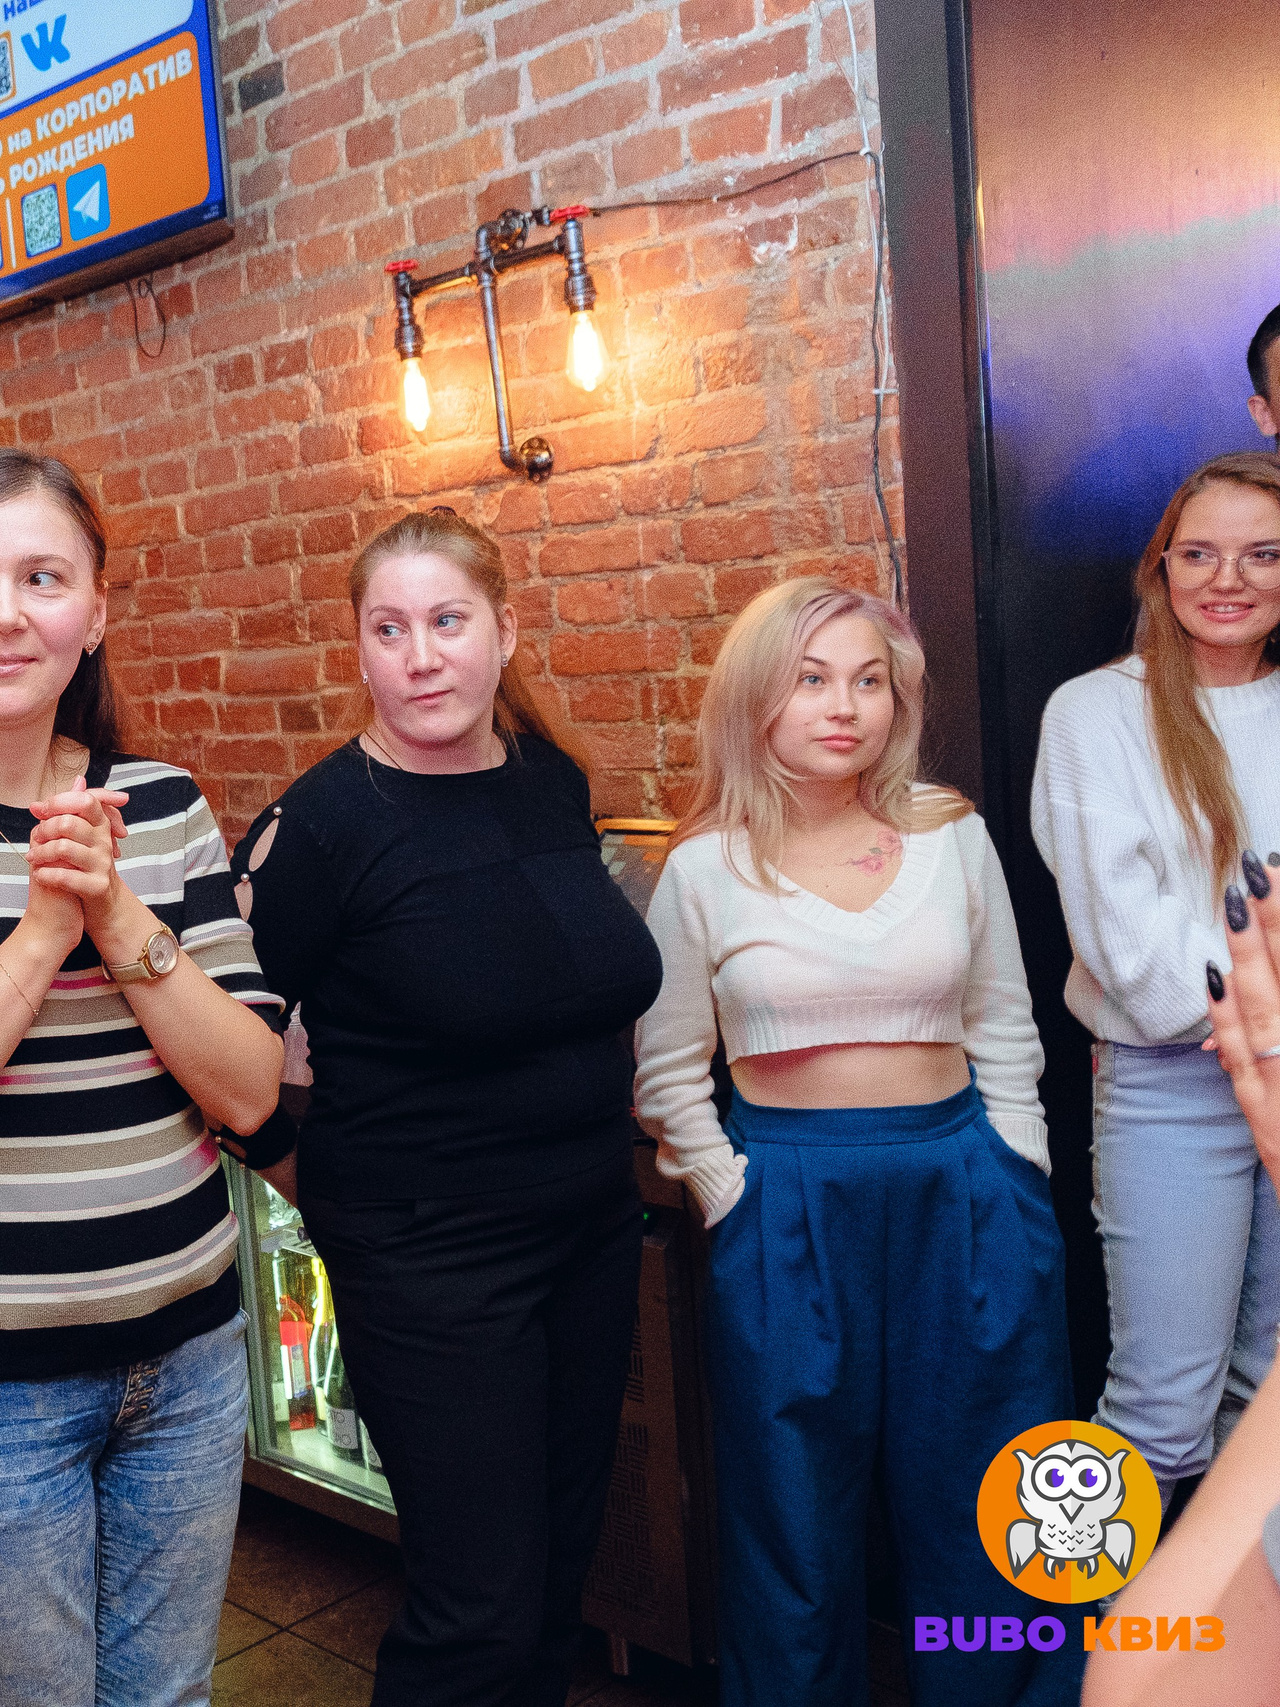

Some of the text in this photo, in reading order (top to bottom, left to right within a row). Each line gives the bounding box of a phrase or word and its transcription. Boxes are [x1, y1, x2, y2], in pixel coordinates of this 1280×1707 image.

[7, 128, 32, 154] на
[35, 48, 193, 141] КОРПОРАТИВ
[9, 112, 135, 189] РОЖДЕНИЯ
